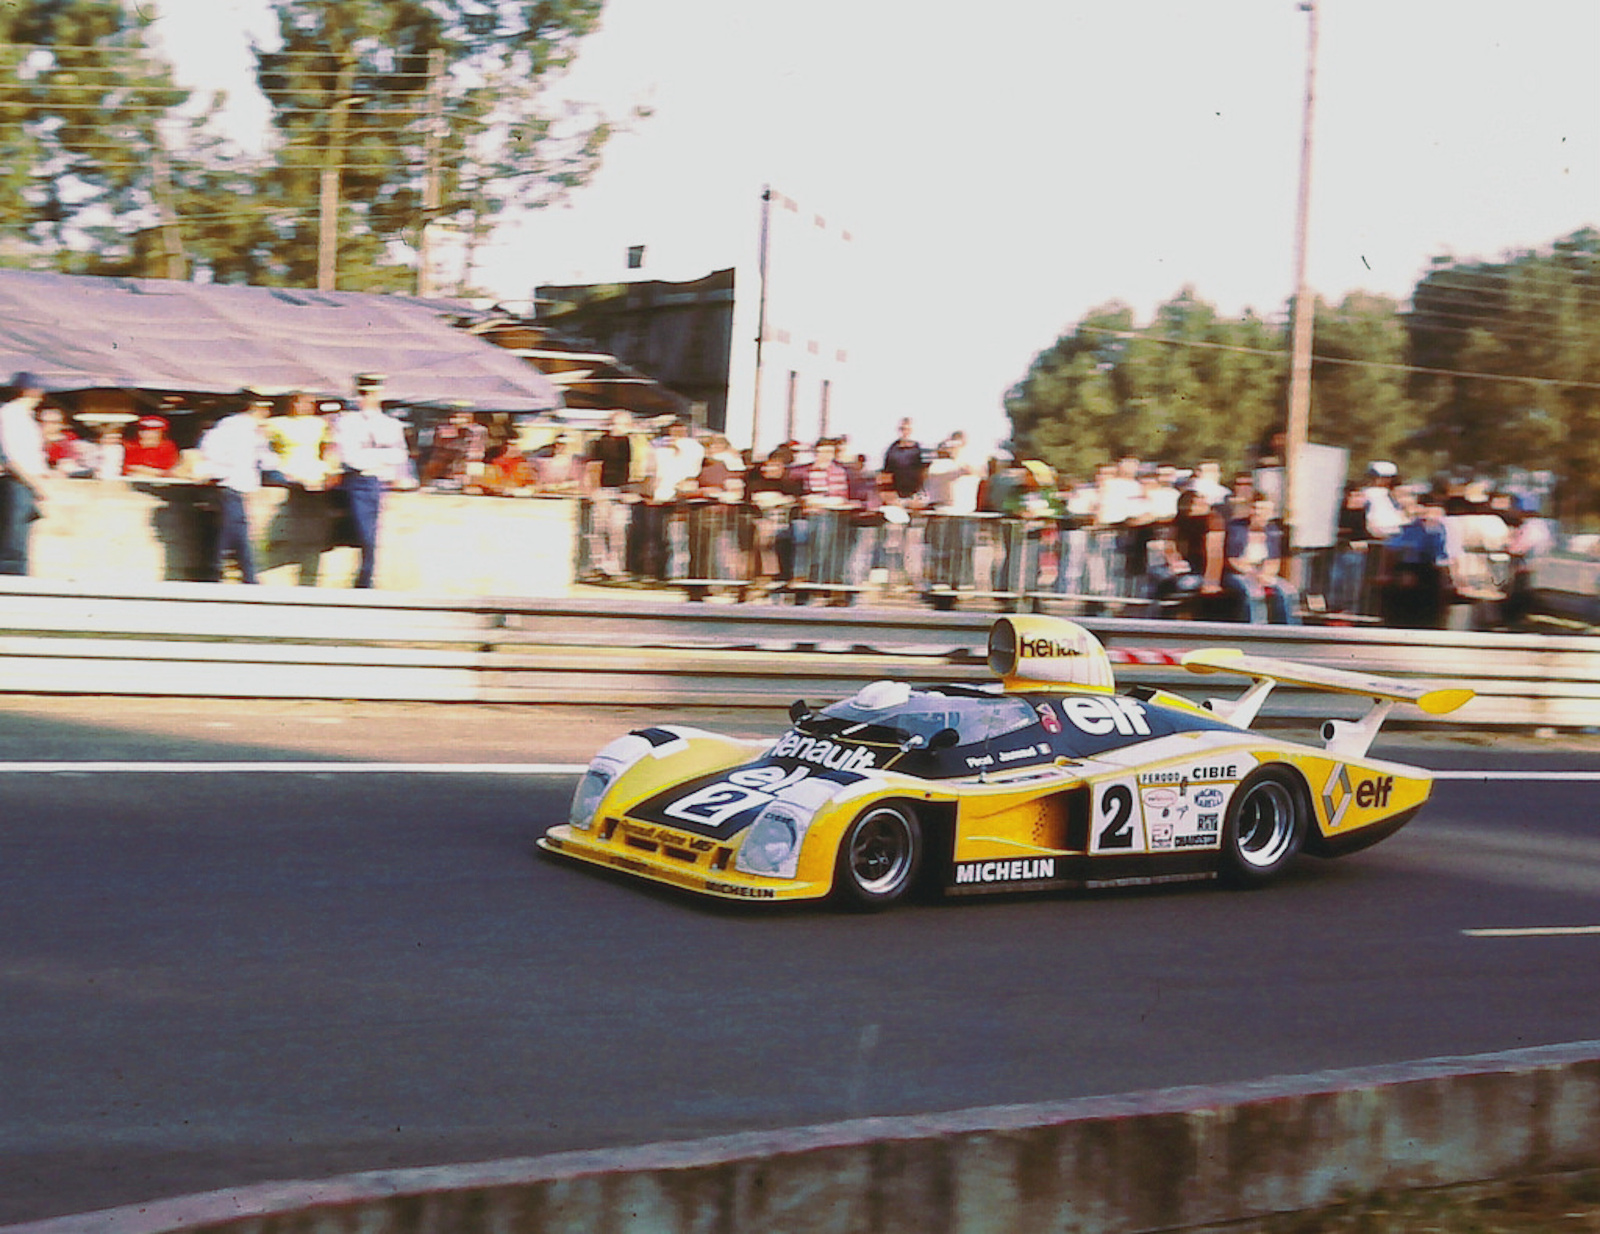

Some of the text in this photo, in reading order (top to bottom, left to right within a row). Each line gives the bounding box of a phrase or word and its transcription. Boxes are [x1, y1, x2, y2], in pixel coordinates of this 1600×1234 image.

[1019, 633, 1088, 657] Rena
[1061, 696, 1152, 736] elf
[728, 765, 811, 793] el
[1192, 765, 1237, 779] CIBIE
[681, 790, 748, 817] 2
[1356, 776, 1393, 808] elf
[1098, 784, 1133, 849] 2
[955, 859, 1055, 883] MICHELIN
